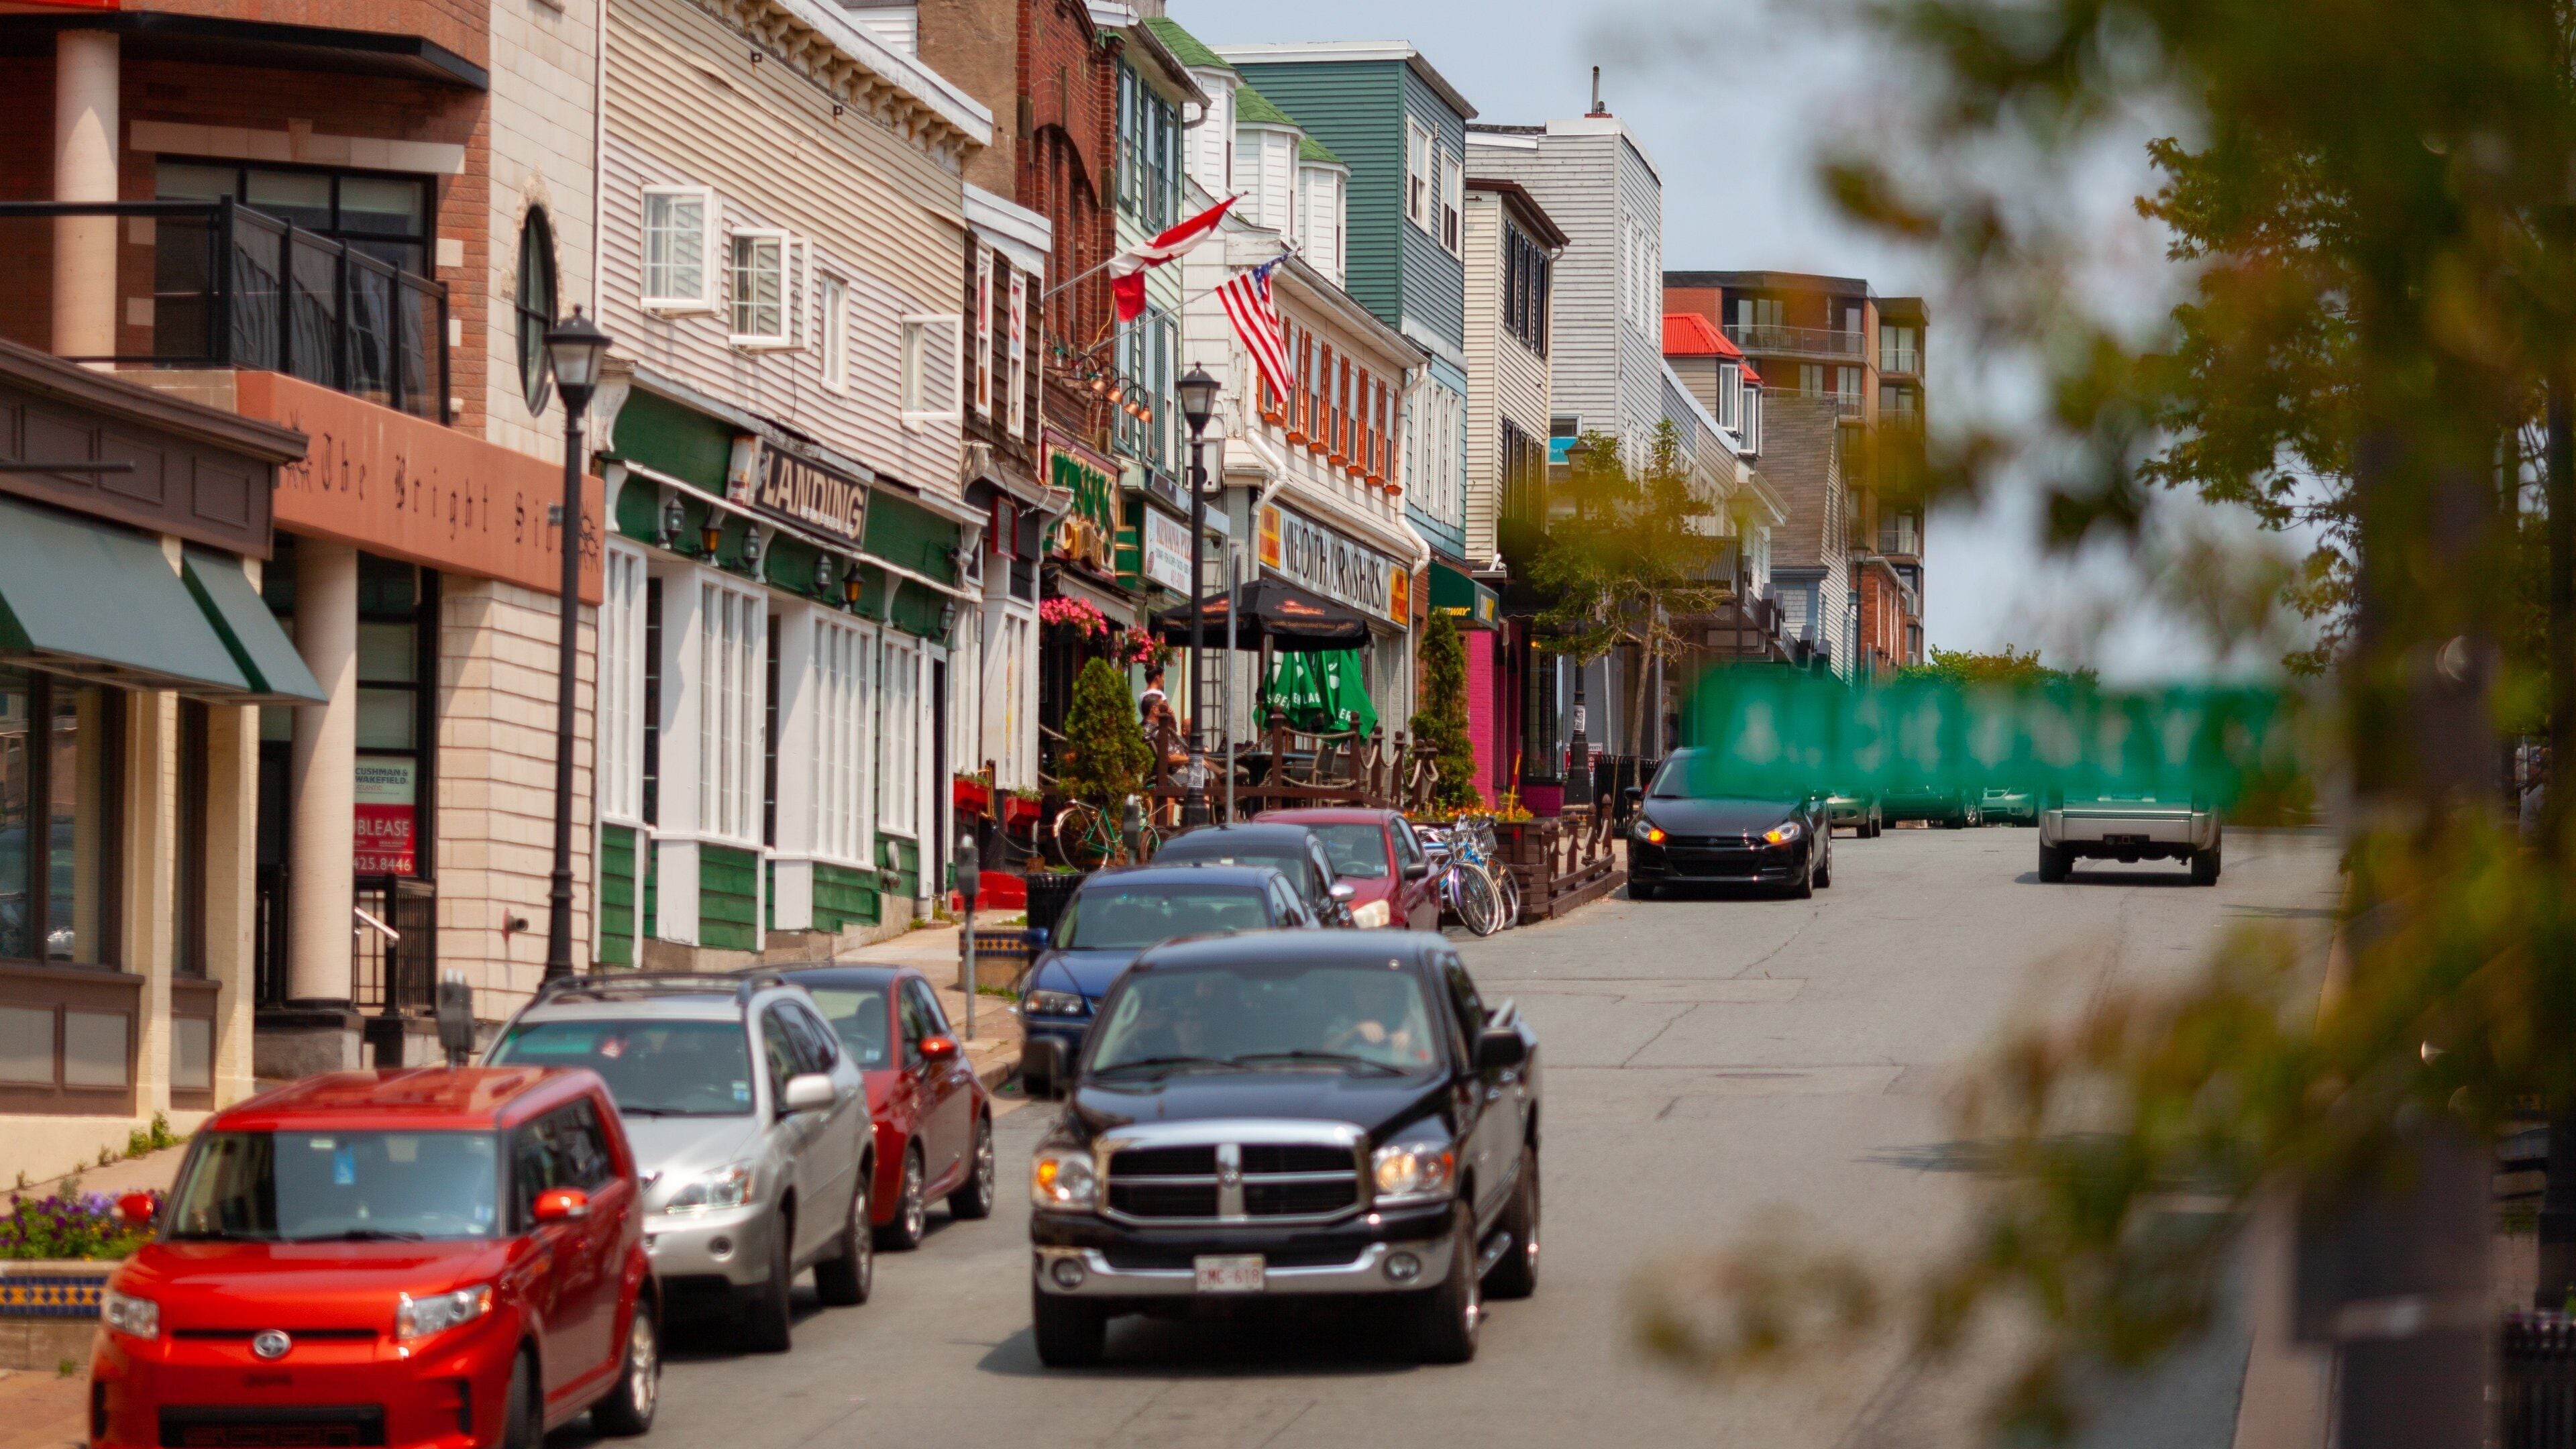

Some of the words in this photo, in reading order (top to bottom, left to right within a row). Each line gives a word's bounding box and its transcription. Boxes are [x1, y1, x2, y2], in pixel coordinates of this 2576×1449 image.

[394, 453, 488, 541] Bright
[763, 450, 864, 539] LANDING
[1288, 621, 1318, 629] Sophisticated
[355, 767, 400, 776] CUSHMAN
[402, 769, 408, 777] &
[355, 775, 407, 784] WAKEFIELD
[355, 819, 409, 837] BLEASE
